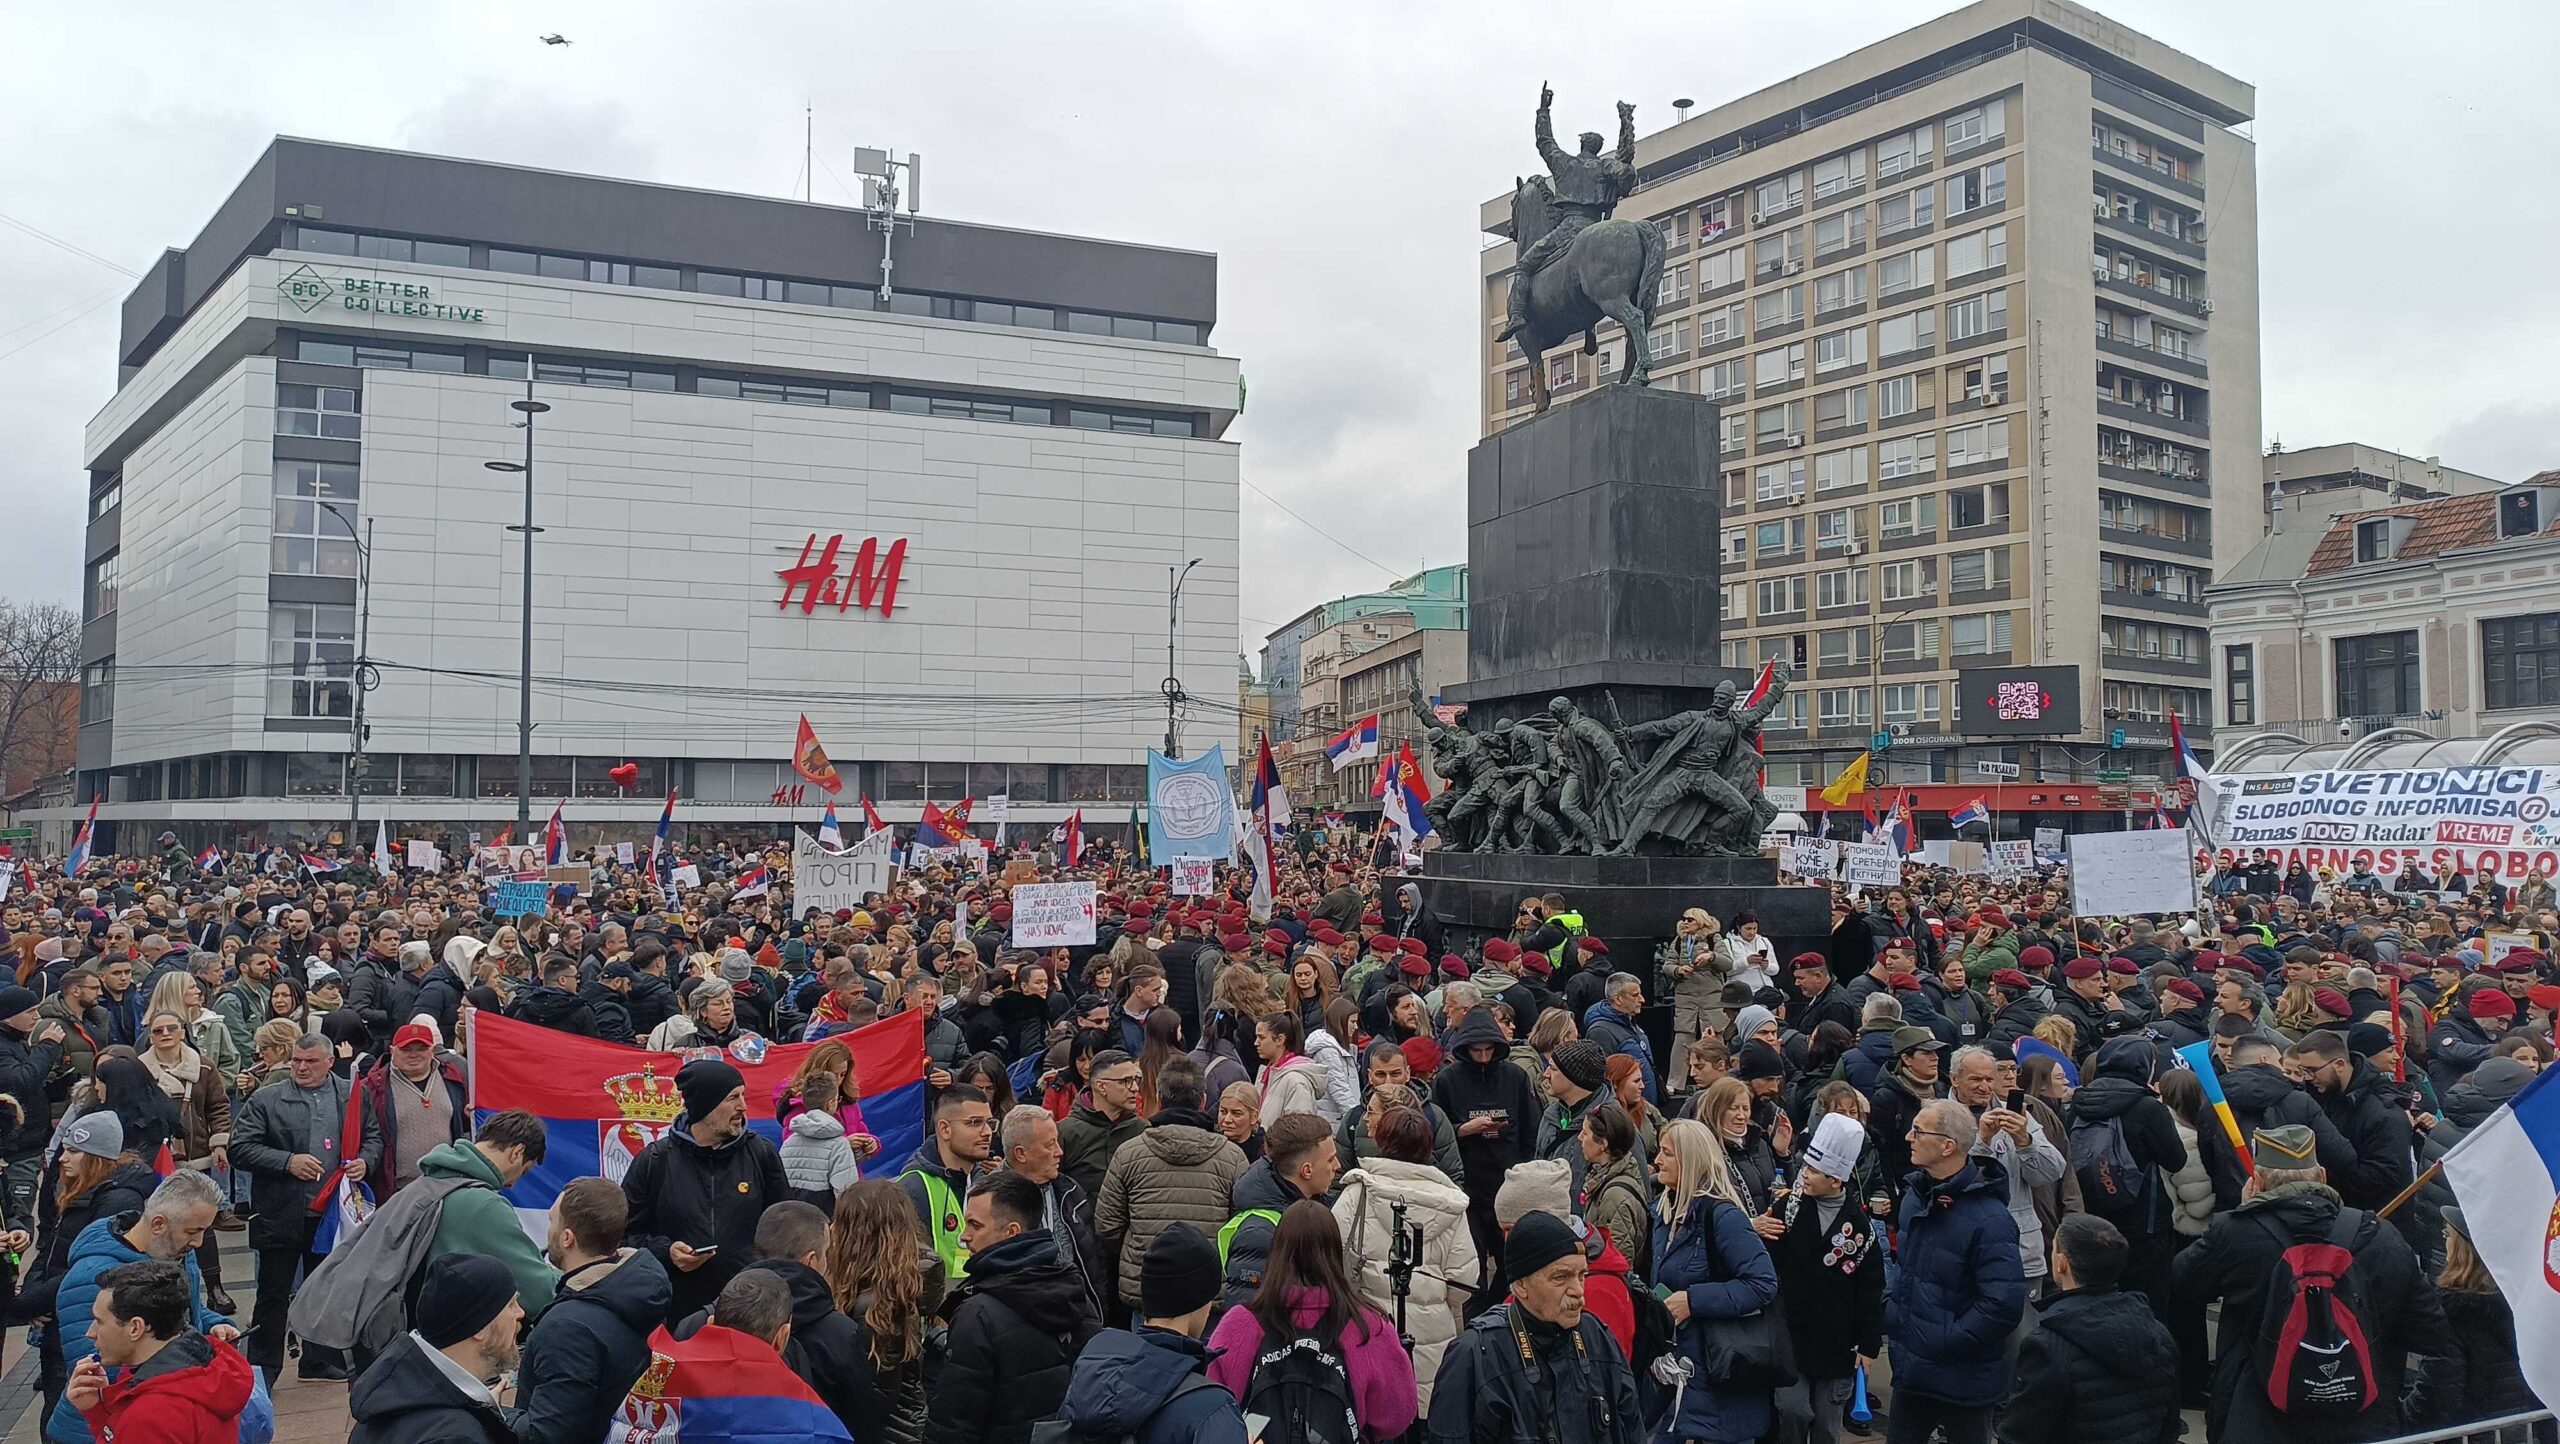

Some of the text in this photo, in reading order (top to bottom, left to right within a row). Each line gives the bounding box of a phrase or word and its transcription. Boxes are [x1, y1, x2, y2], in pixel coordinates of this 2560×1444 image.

[345, 278, 429, 299] BETTER
[344, 297, 483, 322] COLLECTIVE
[779, 533, 907, 618] H&M
[1916, 736, 1963, 744] OSIGURANJE
[771, 784, 805, 804] H&M
[2245, 781, 2293, 791] INSAJDER
[2235, 798, 2368, 820] SLOBODNOG
[2230, 826, 2298, 842] Danas
[2302, 824, 2356, 840] nova
[2362, 823, 2431, 842] Radar
[2441, 822, 2510, 844] VREME
[1798, 837, 1831, 850] ПРАВО
[1850, 846, 1885, 856] ПОНОВО
[1796, 853, 1822, 867] КУЧЕ
[1852, 857, 1897, 868] СРЕЋЕМО
[1518, 1331, 1532, 1358] Nikon
[1261, 1344, 1292, 1366] ADIDAS
